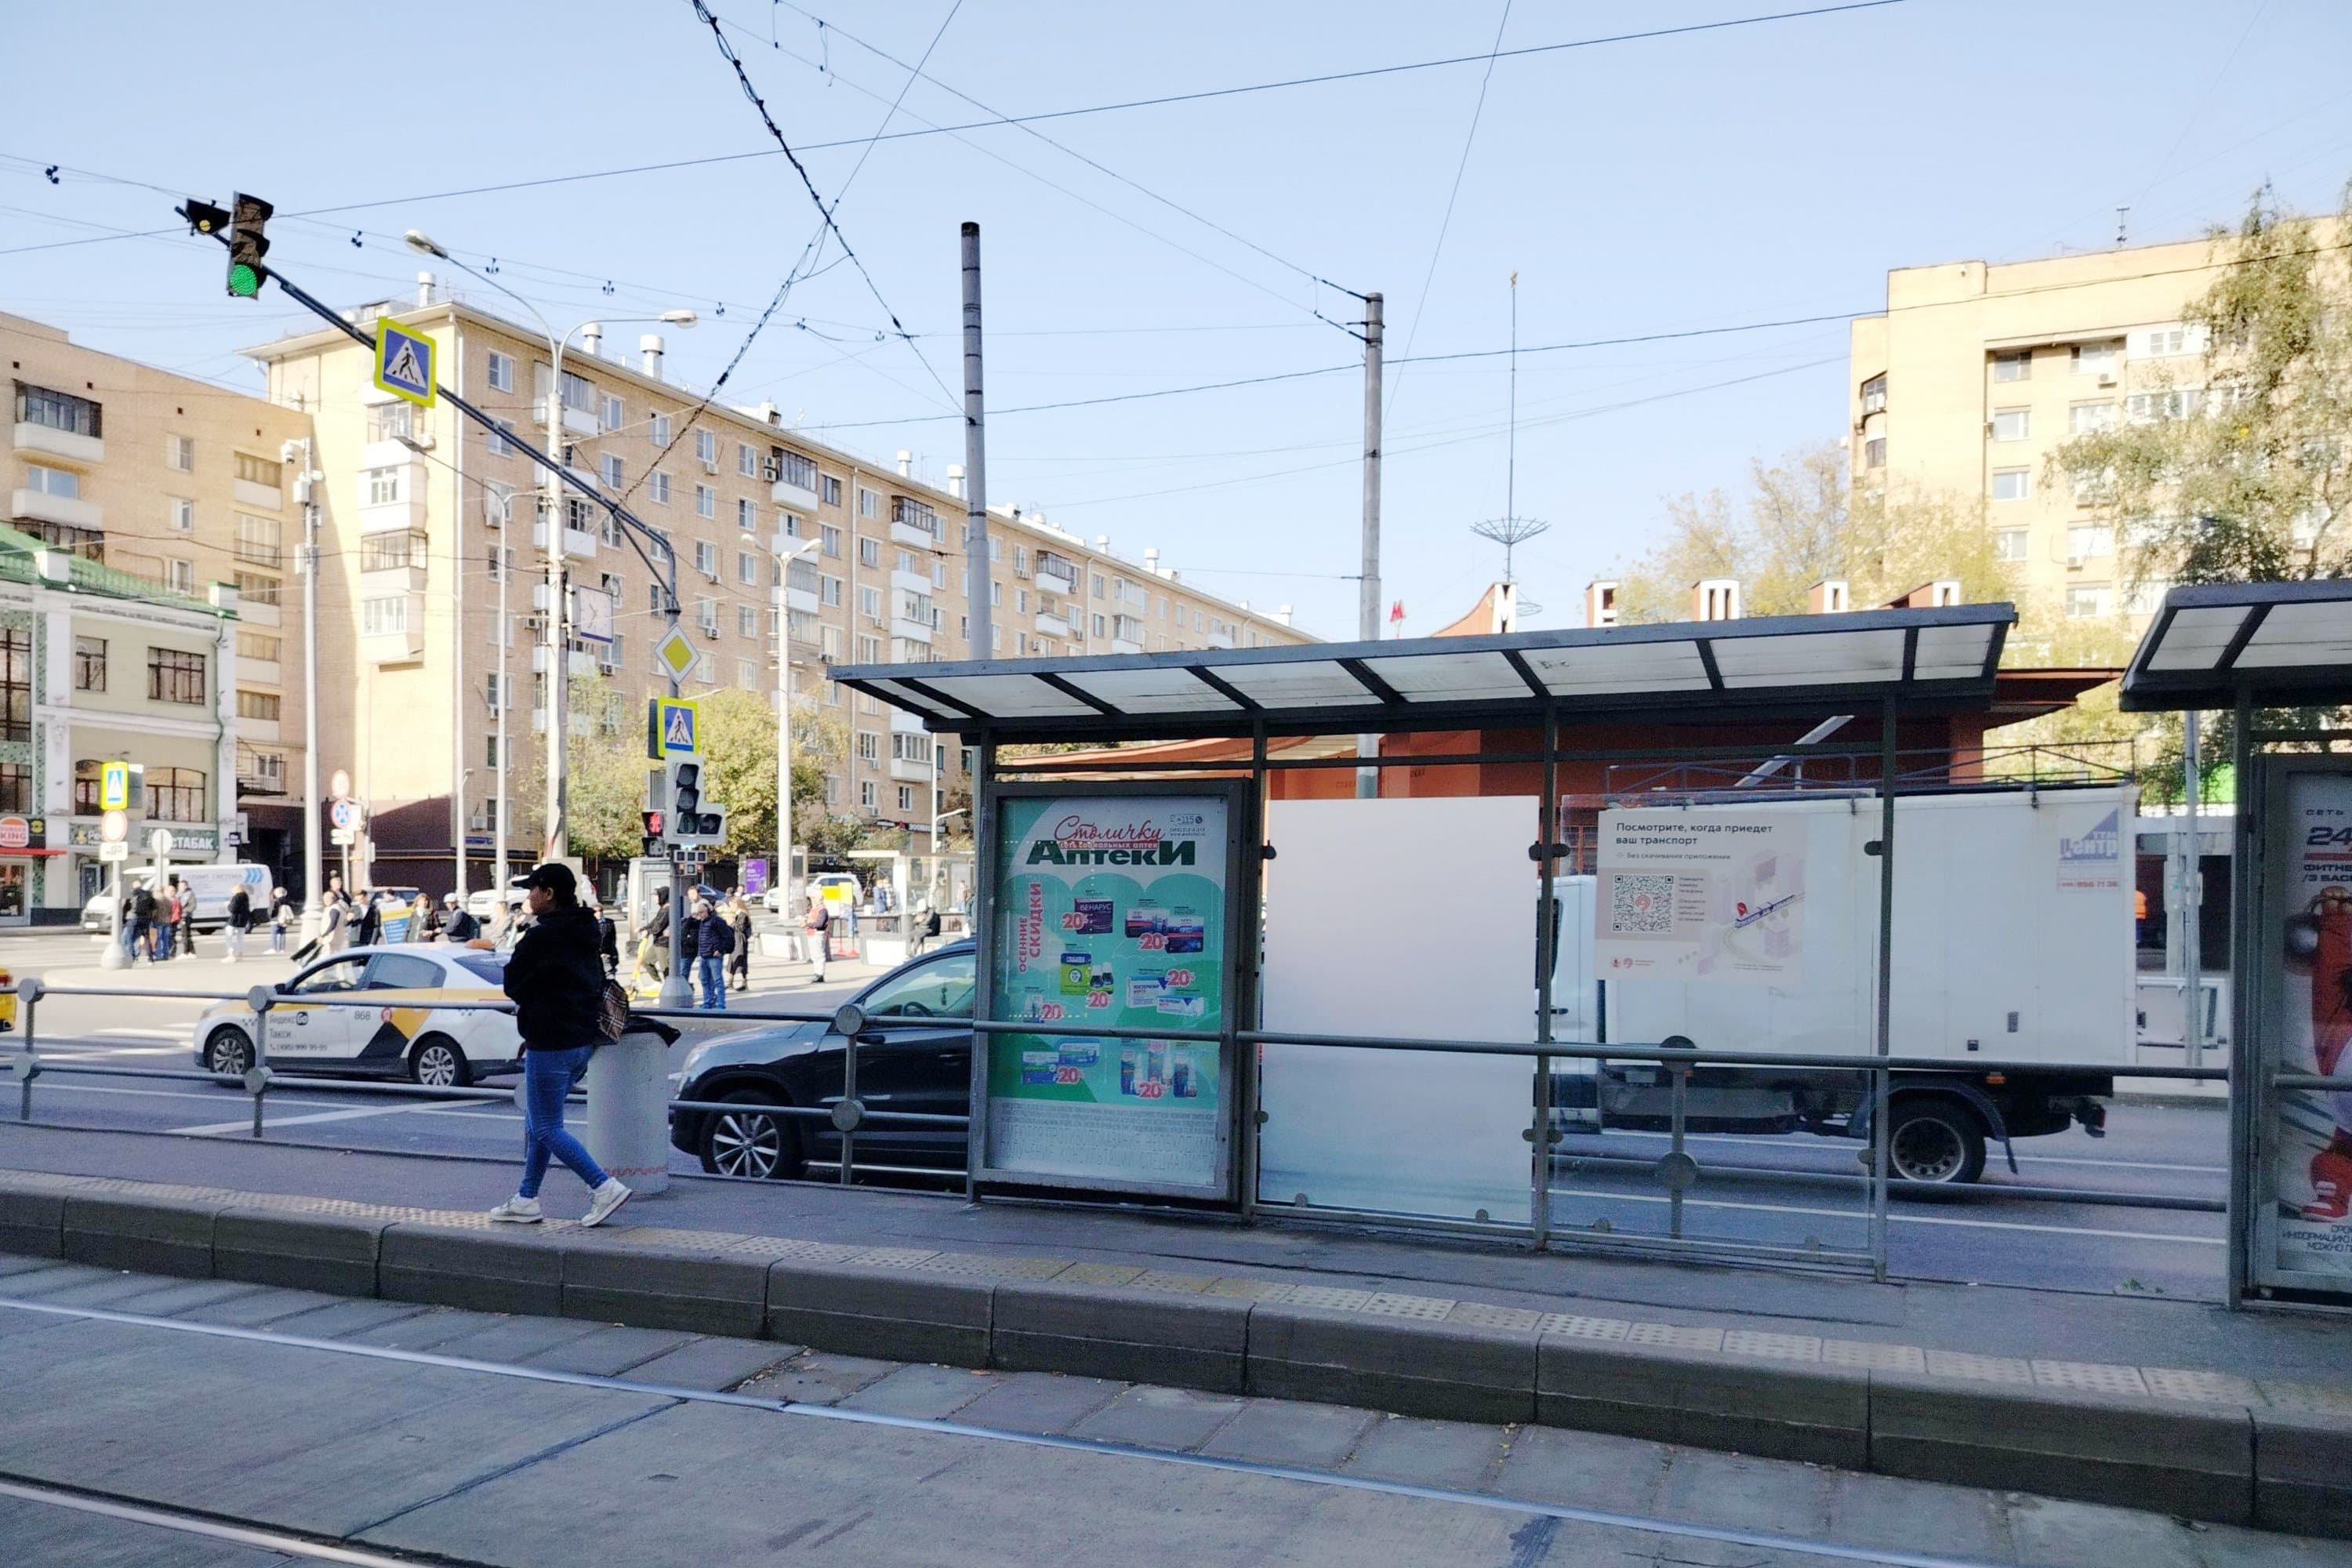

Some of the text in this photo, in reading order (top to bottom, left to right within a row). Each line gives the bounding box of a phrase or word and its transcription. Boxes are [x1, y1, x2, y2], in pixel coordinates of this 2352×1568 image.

[1054, 815, 1166, 840] Столички
[1616, 822, 1773, 834] Посмотрите, когда приедет
[1639, 837, 1698, 846] транспорт
[1029, 883, 1043, 958] СКИДКИ
[1019, 917, 1028, 972] ОСЕННИЕ
[270, 1029, 292, 1038] Такси
